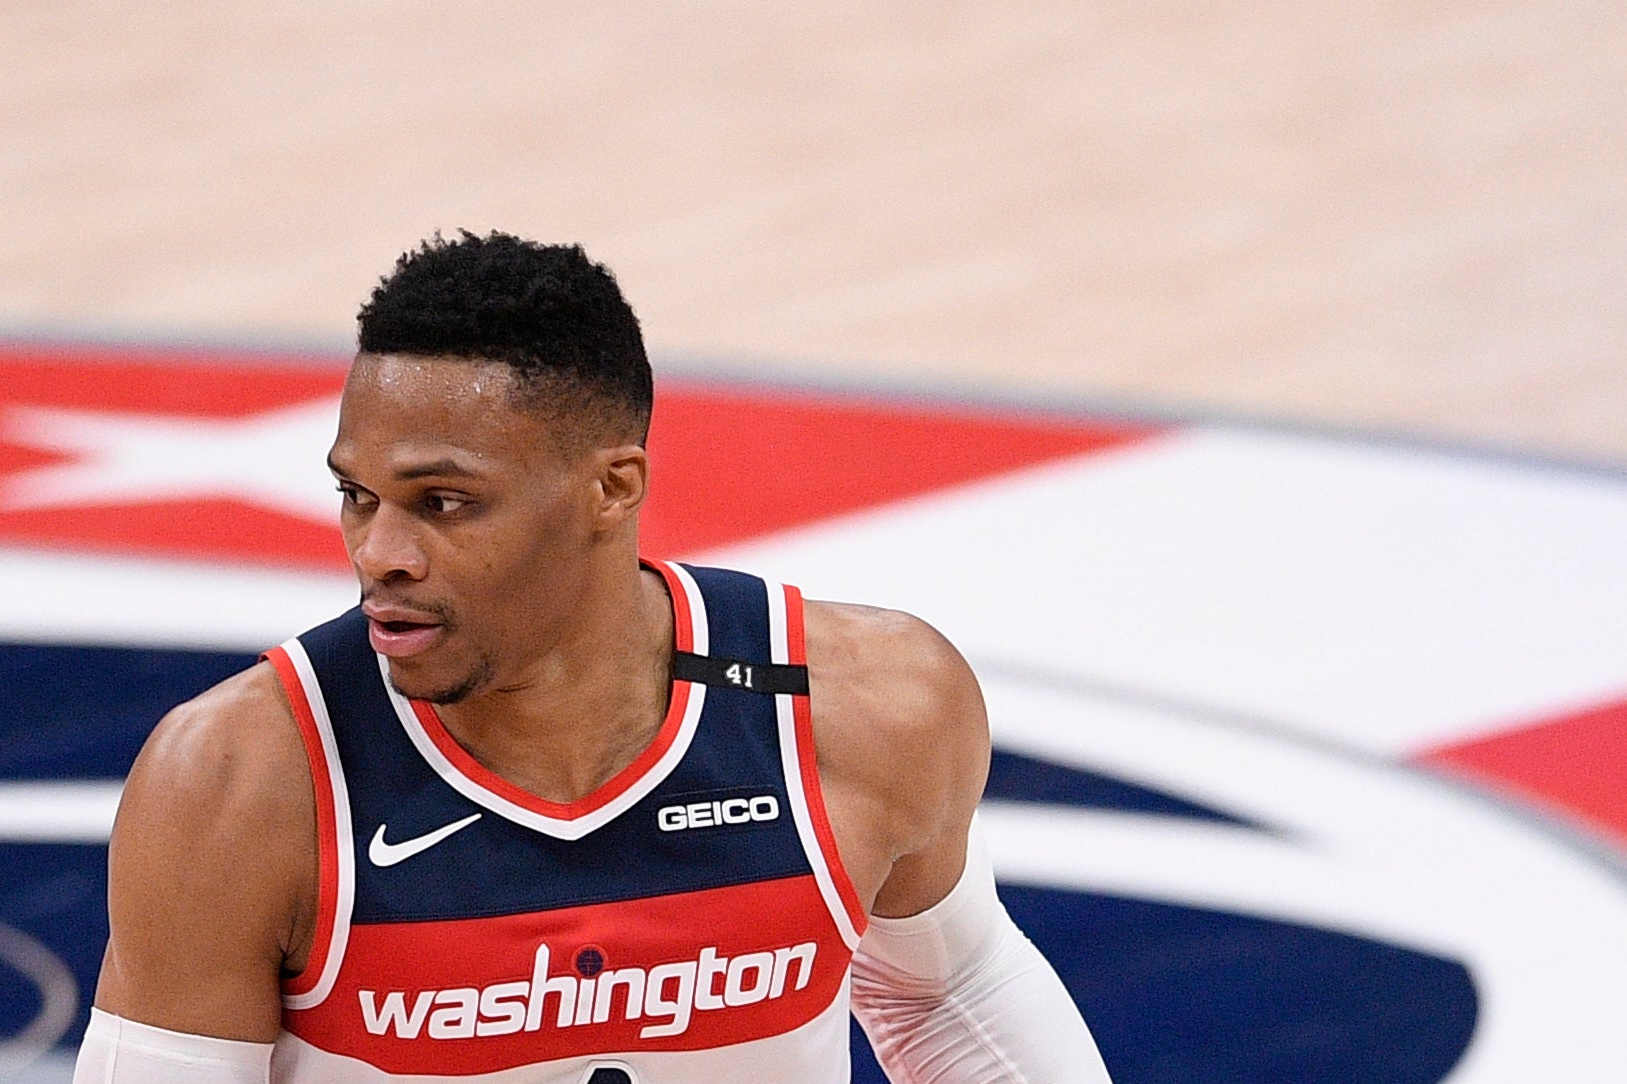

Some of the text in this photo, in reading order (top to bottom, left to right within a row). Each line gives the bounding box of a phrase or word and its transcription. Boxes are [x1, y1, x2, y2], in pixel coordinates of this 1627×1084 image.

[726, 664, 753, 688] 41
[657, 795, 780, 832] GEICO
[357, 942, 818, 1040] washington
